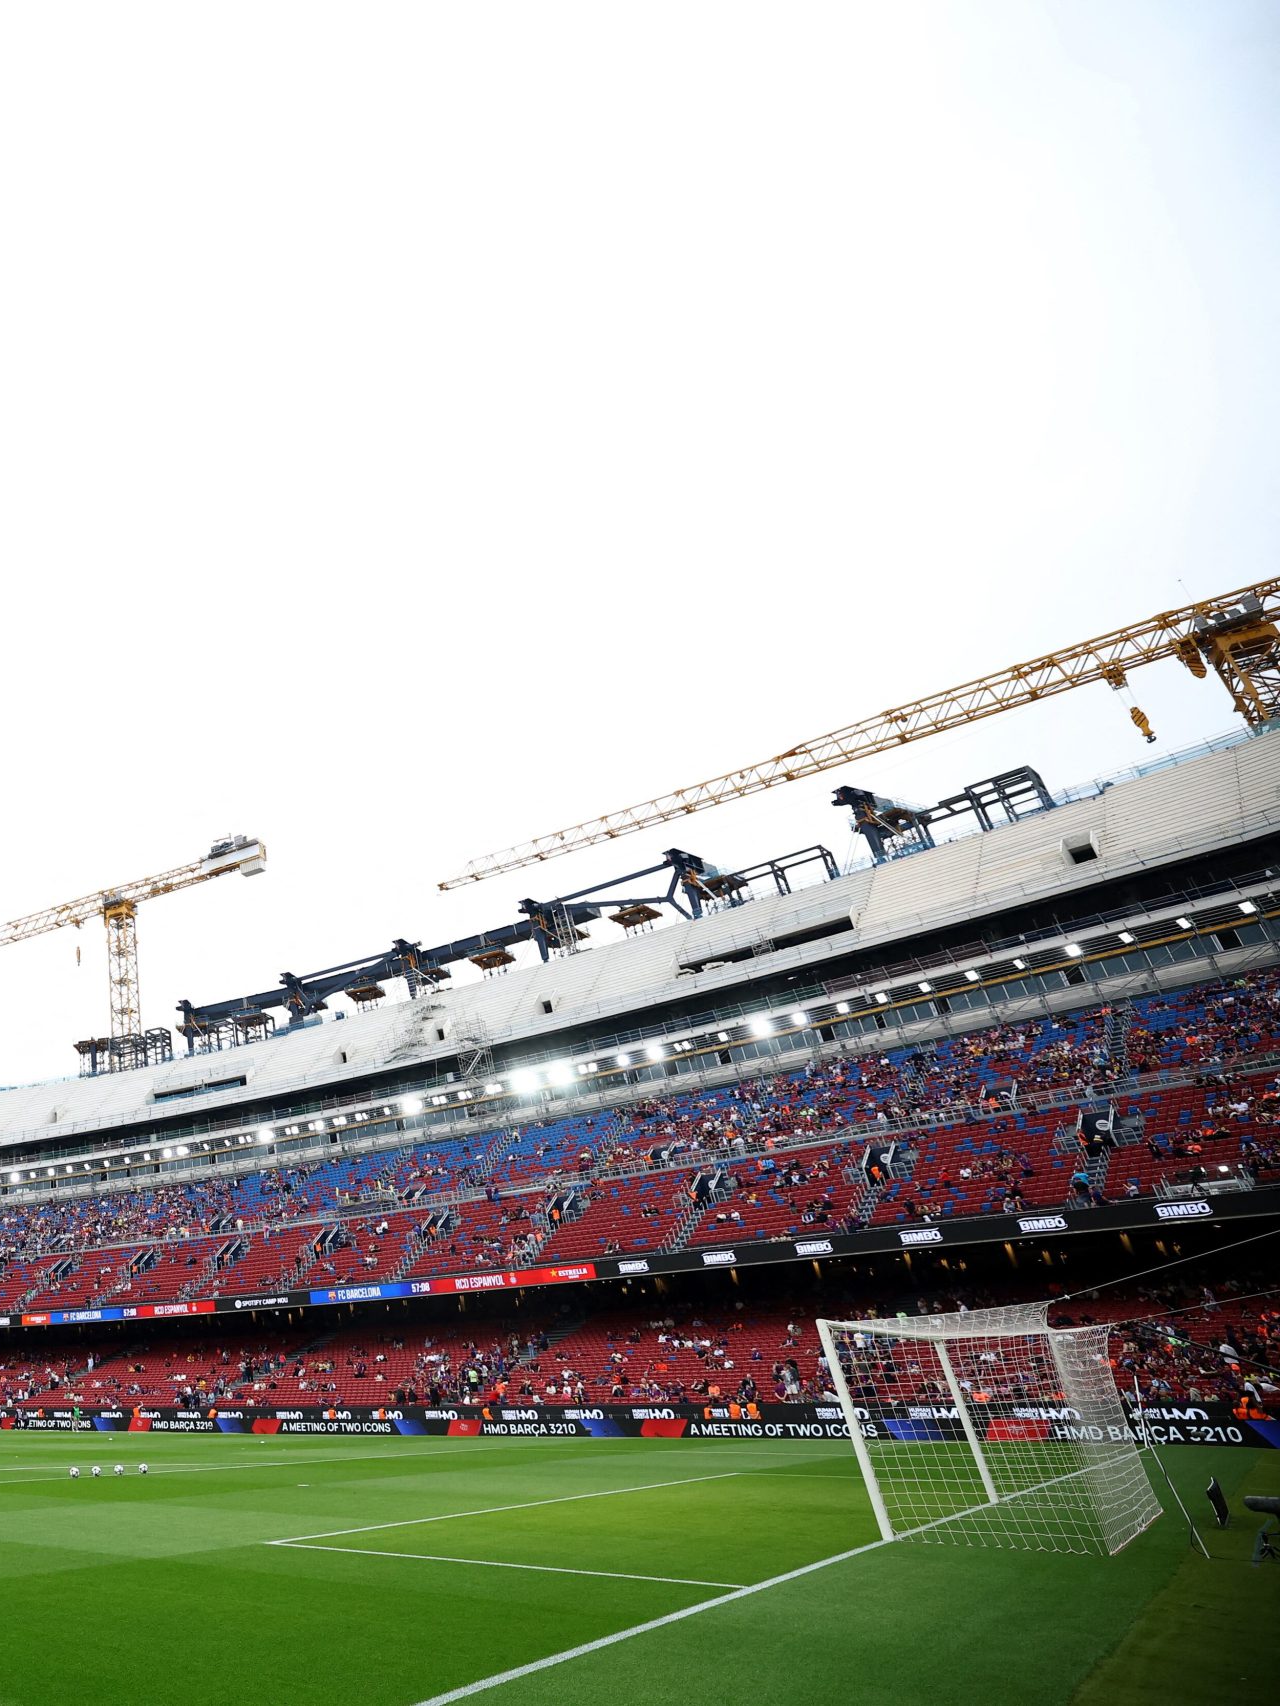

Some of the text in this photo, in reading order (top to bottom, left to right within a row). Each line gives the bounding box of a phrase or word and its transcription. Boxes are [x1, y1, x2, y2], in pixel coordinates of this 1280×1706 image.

[1156, 1203, 1210, 1217] BIMBO
[1019, 1218, 1066, 1231] BIMBO
[900, 1230, 941, 1243] BIMBO
[796, 1242, 832, 1253] BIMBO
[703, 1253, 735, 1263] BIMBO
[558, 1268, 588, 1276] ESTRELLA
[619, 1262, 648, 1272] BIMBO
[455, 1275, 505, 1289] RCD ESPANYOL
[411, 1283, 430, 1292] 57:08
[338, 1287, 381, 1300] FC BARCELONA
[165, 1304, 188, 1314] ESPANYOL
[76, 1311, 101, 1320] BARCELONA
[438, 1410, 458, 1420] HMD
[516, 1410, 538, 1420] HMD
[580, 1409, 604, 1419] HMD
[649, 1409, 674, 1419] HMD
[836, 1408, 869, 1419] HD
[932, 1408, 960, 1418] HM
[1039, 1408, 1082, 1419] HMD
[1161, 1408, 1208, 1420] HMD
[170, 1421, 194, 1431] BARÇA
[282, 1423, 391, 1432] A MEETING OF TWO ICONS
[483, 1424, 576, 1437] HMD BARÇA 3210
[690, 1424, 700, 1435] A
[702, 1424, 762, 1436] MEETING
[765, 1424, 784, 1436] OF
[785, 1424, 823, 1436] TWO
[1055, 1426, 1242, 1444] HMD BARÇA 3210
